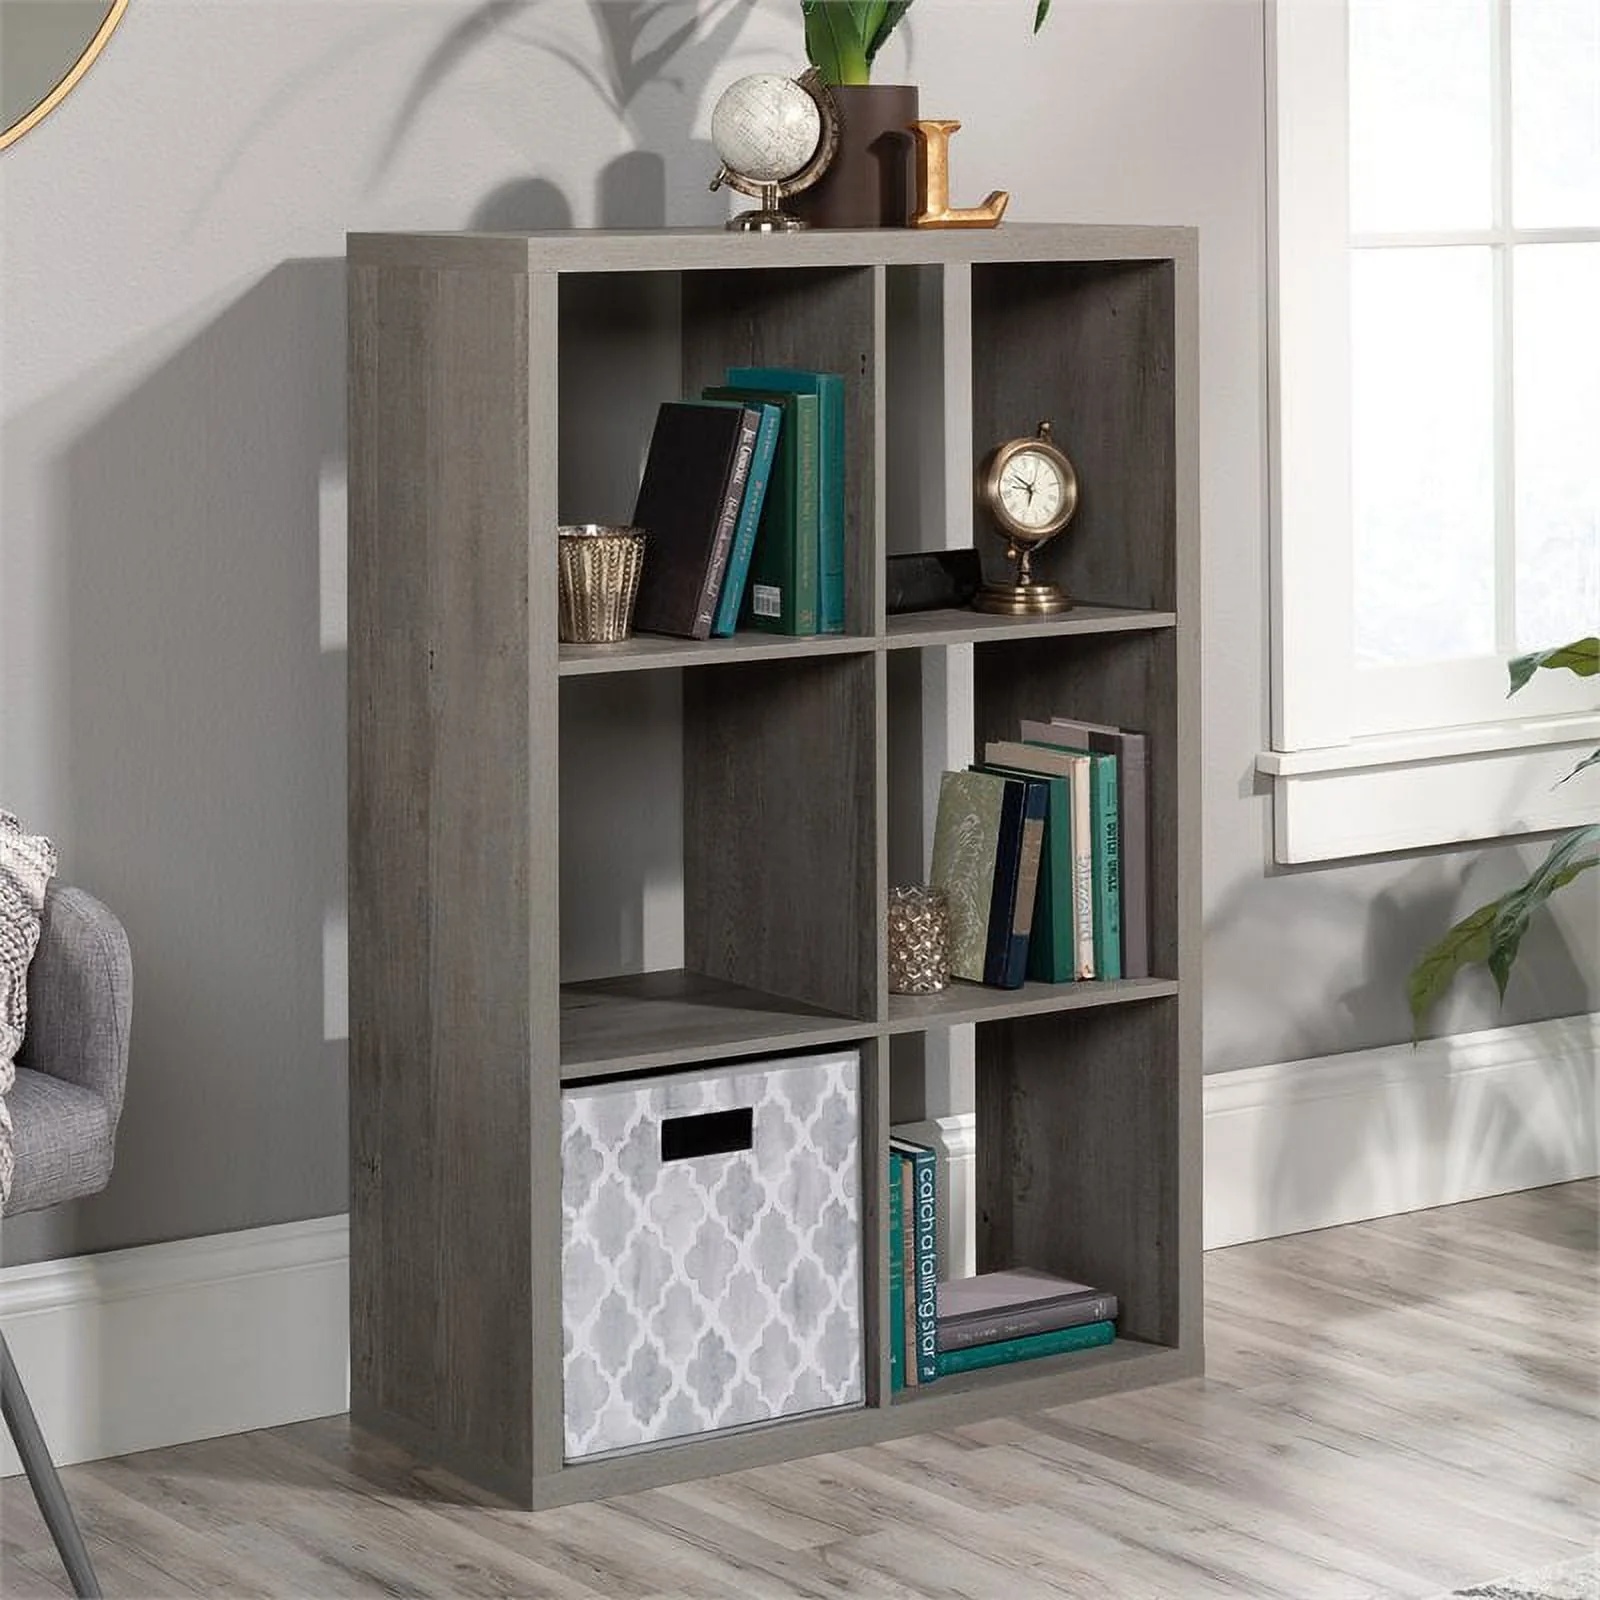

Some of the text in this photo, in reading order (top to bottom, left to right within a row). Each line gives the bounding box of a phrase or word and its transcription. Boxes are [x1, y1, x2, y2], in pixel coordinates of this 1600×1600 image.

[920, 1168, 936, 1232] catch
[921, 1235, 934, 1250] a
[918, 1253, 937, 1317] falling
[922, 1320, 936, 1359] star
